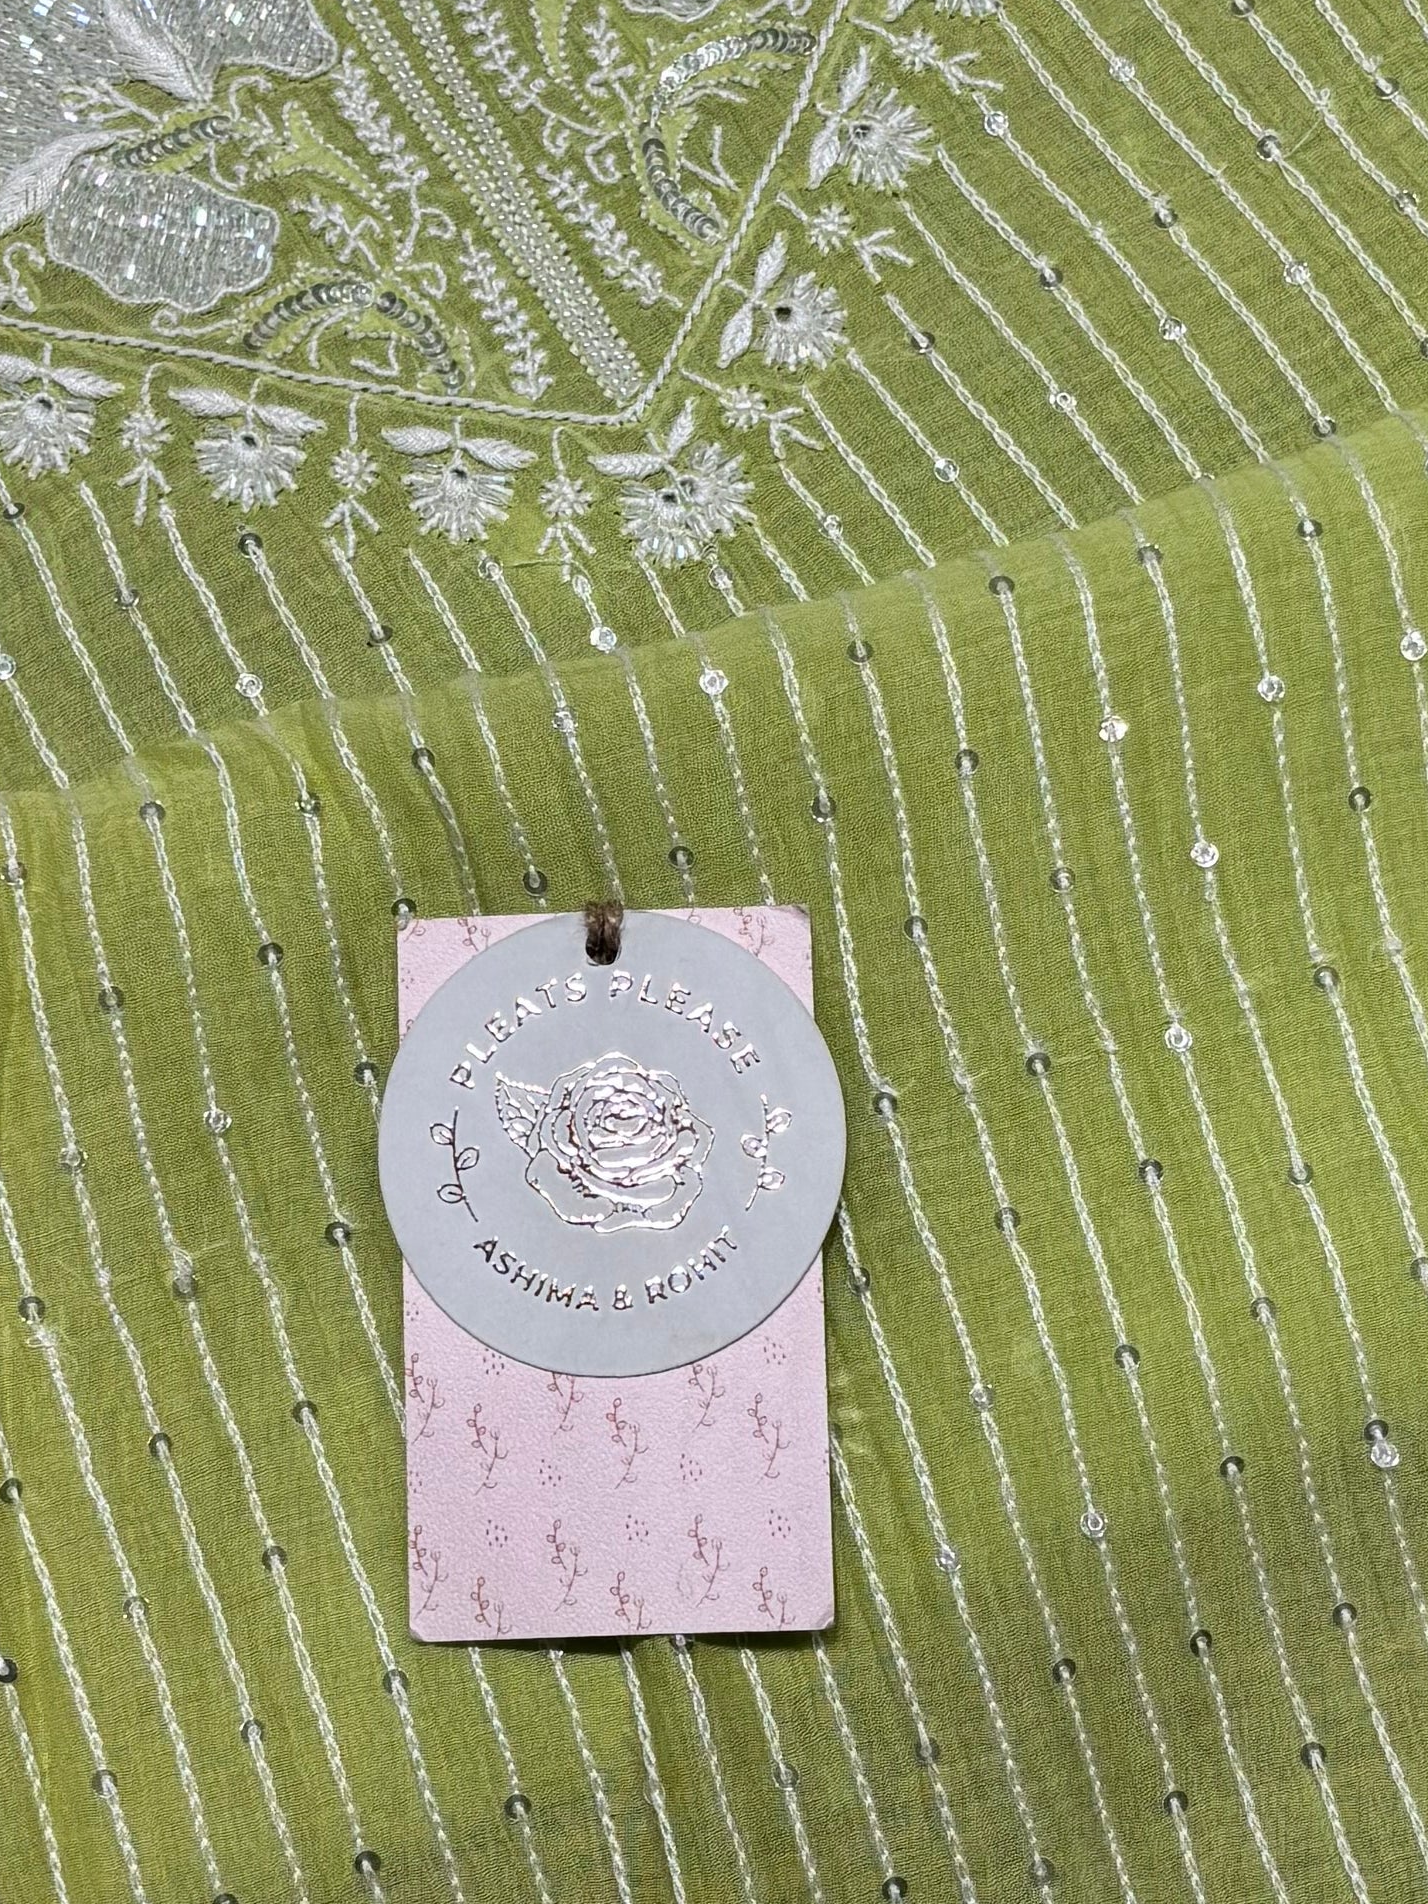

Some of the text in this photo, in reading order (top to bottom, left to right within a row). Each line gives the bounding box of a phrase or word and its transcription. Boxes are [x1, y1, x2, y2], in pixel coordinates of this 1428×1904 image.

[449, 970, 760, 1089] PLEATS PLEASE
[474, 1225, 738, 1311] ASHIMA & ROHIT
